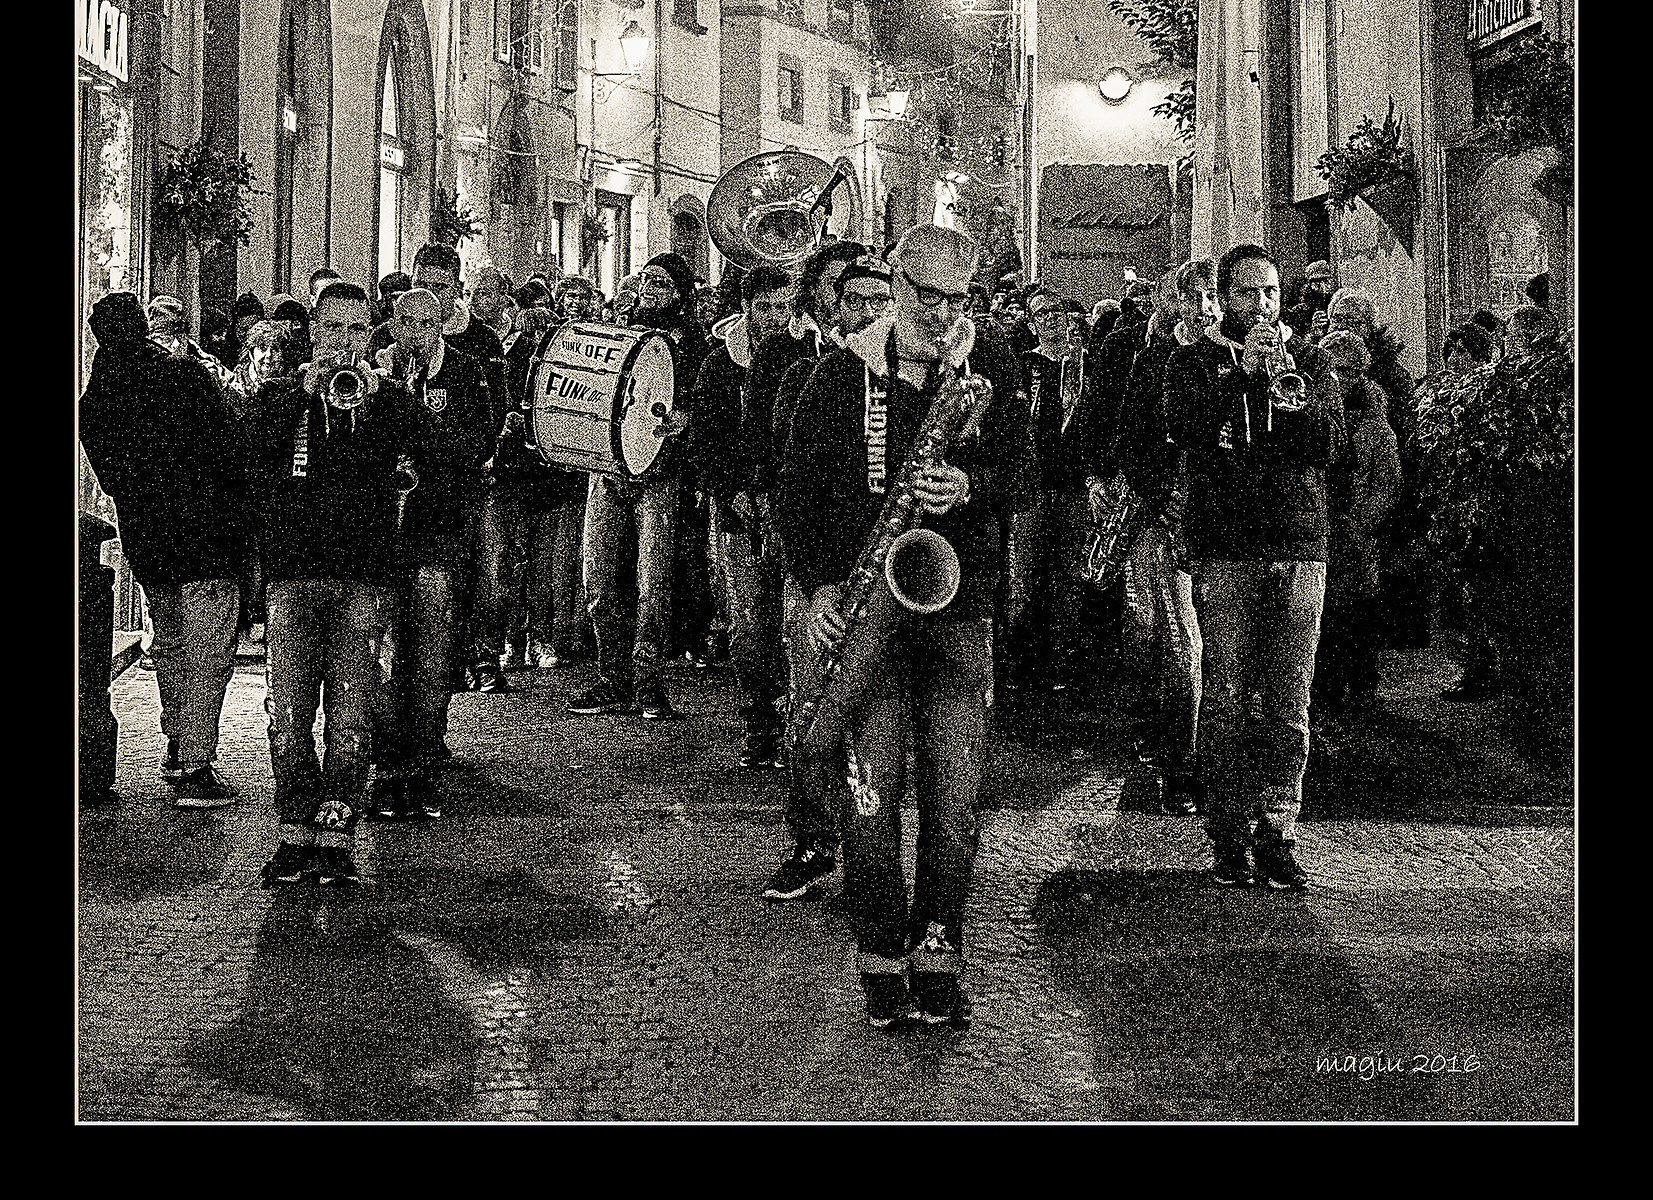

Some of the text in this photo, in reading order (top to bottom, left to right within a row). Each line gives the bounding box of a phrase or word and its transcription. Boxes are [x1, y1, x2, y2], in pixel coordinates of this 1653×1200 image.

[585, 344, 621, 363] OFF
[546, 371, 592, 401] FUNK
[867, 386, 888, 494] FUNKOFF
